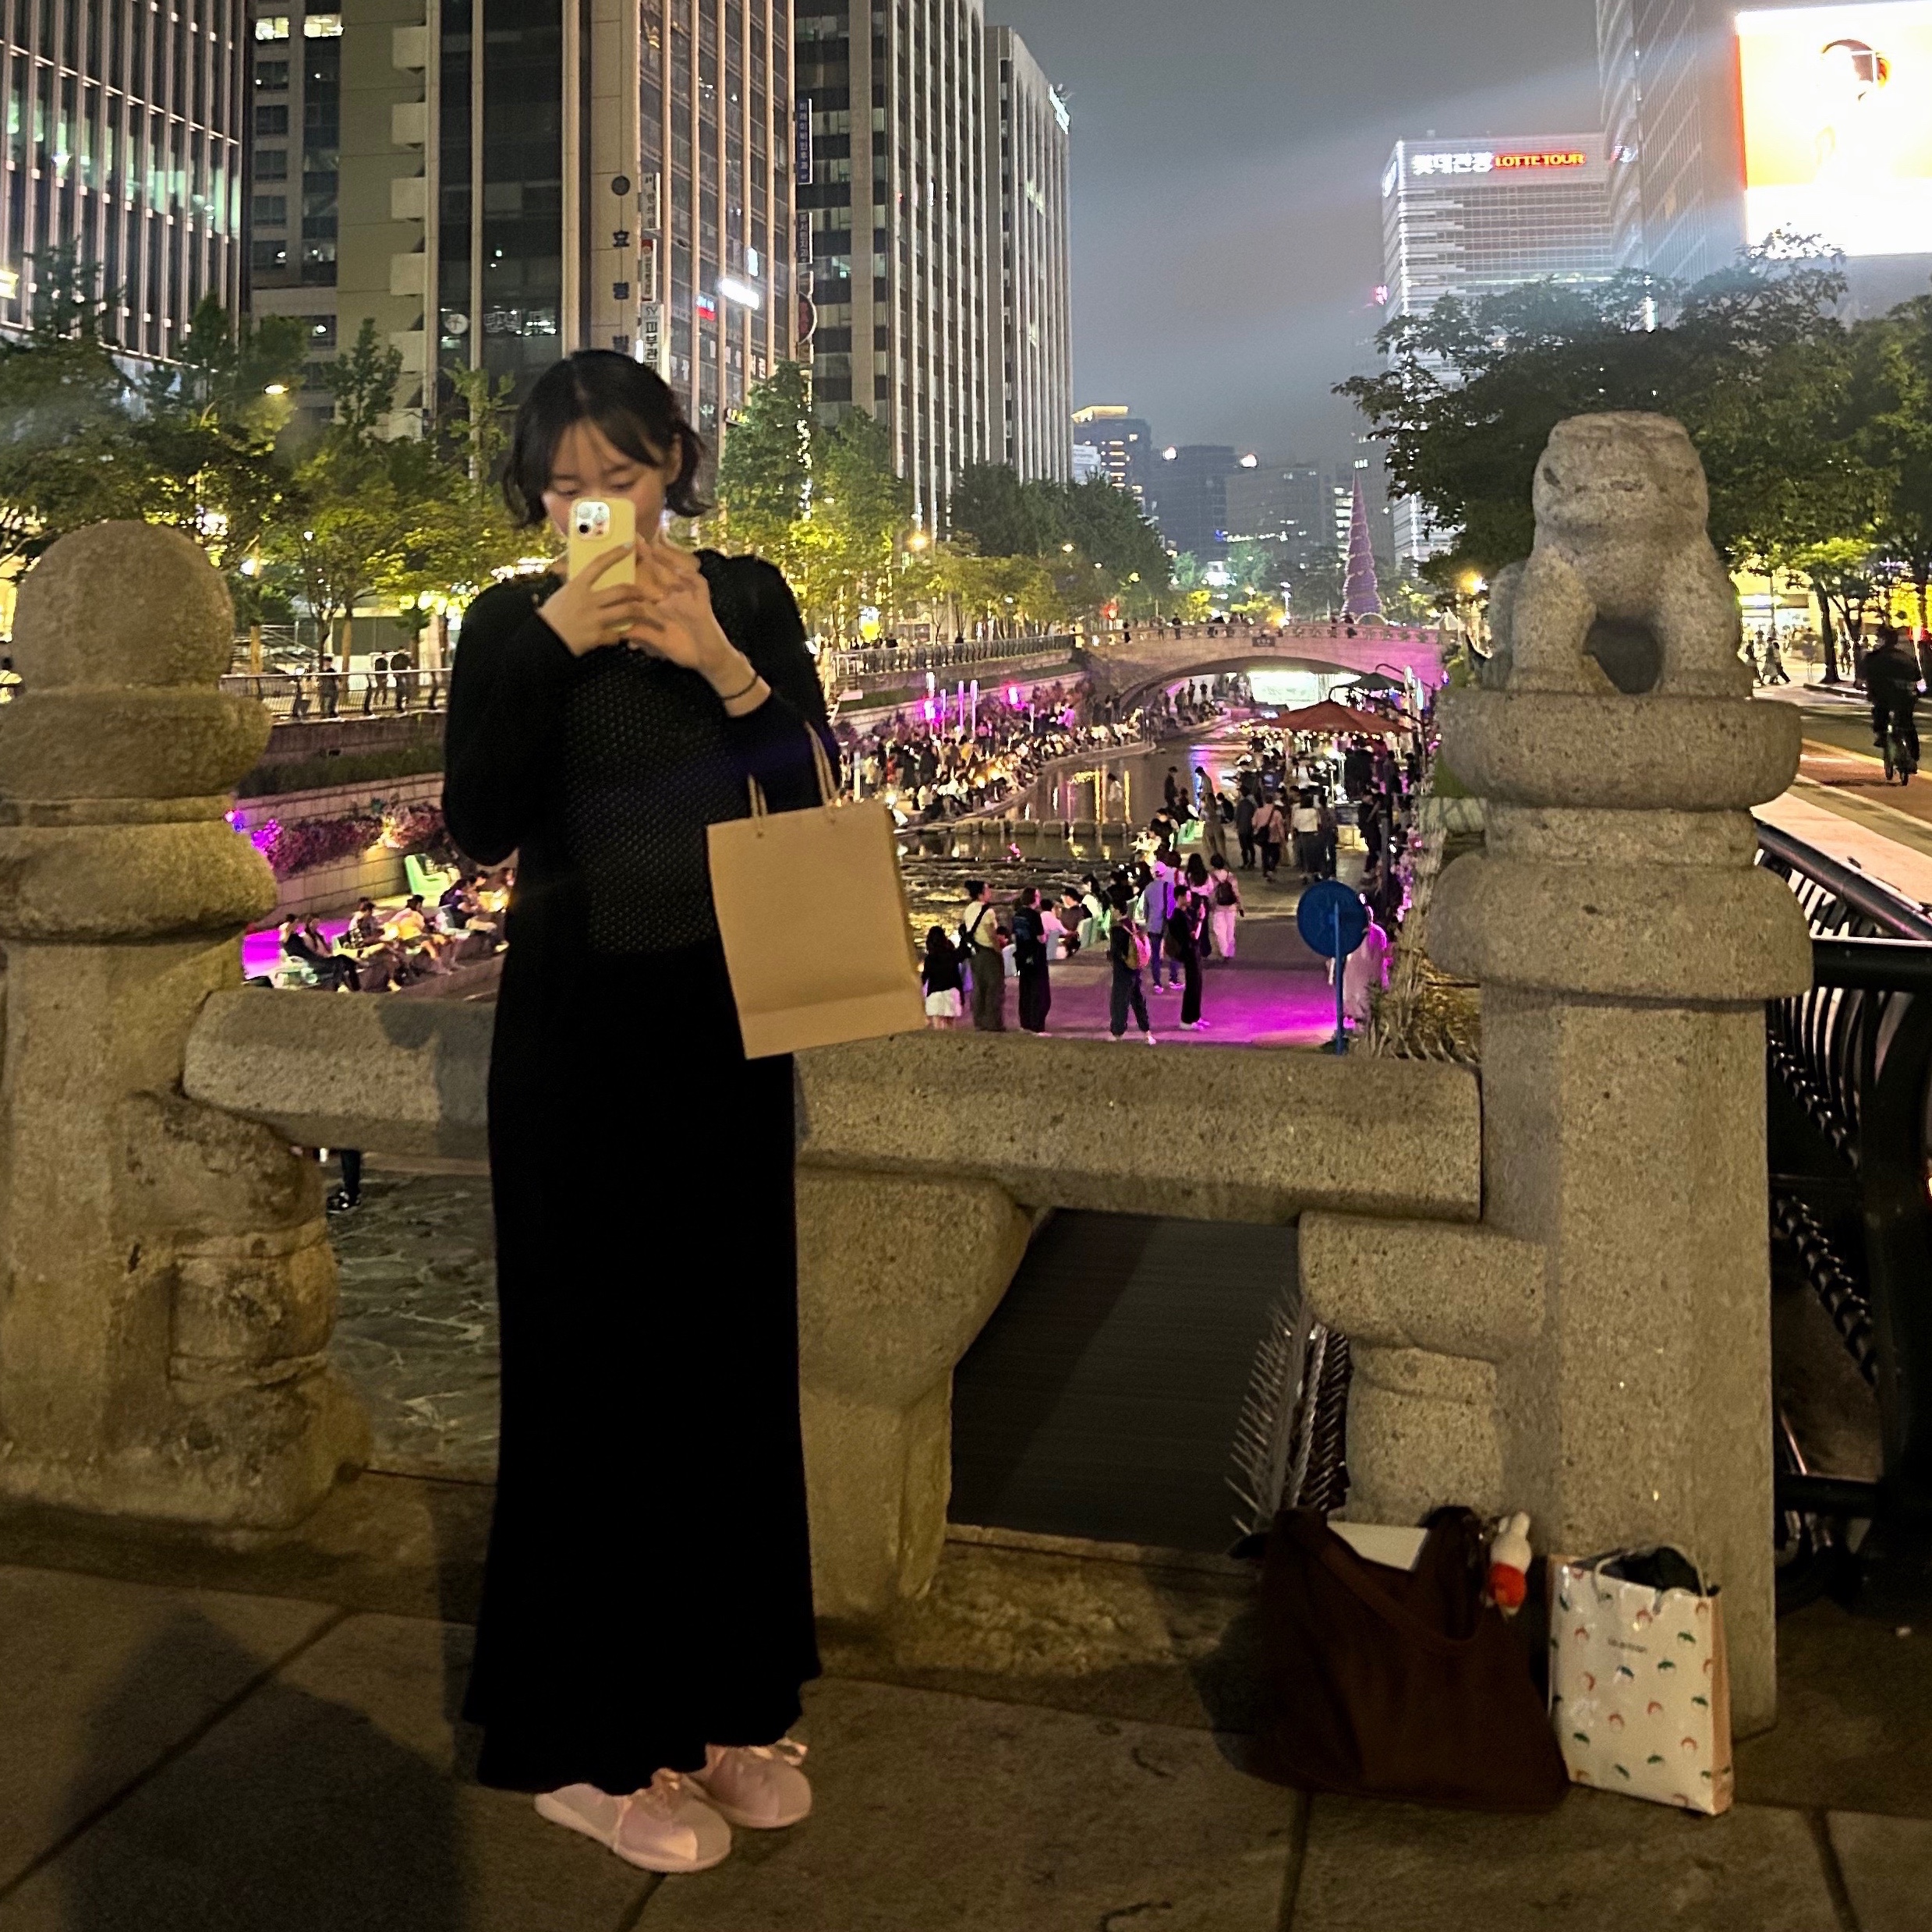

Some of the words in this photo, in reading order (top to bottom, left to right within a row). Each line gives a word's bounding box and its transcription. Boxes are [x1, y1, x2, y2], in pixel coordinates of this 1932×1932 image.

[1412, 152, 1494, 175] 롯데관광
[1495, 155, 1541, 168] LOTTE
[1542, 153, 1585, 166] TOUR
